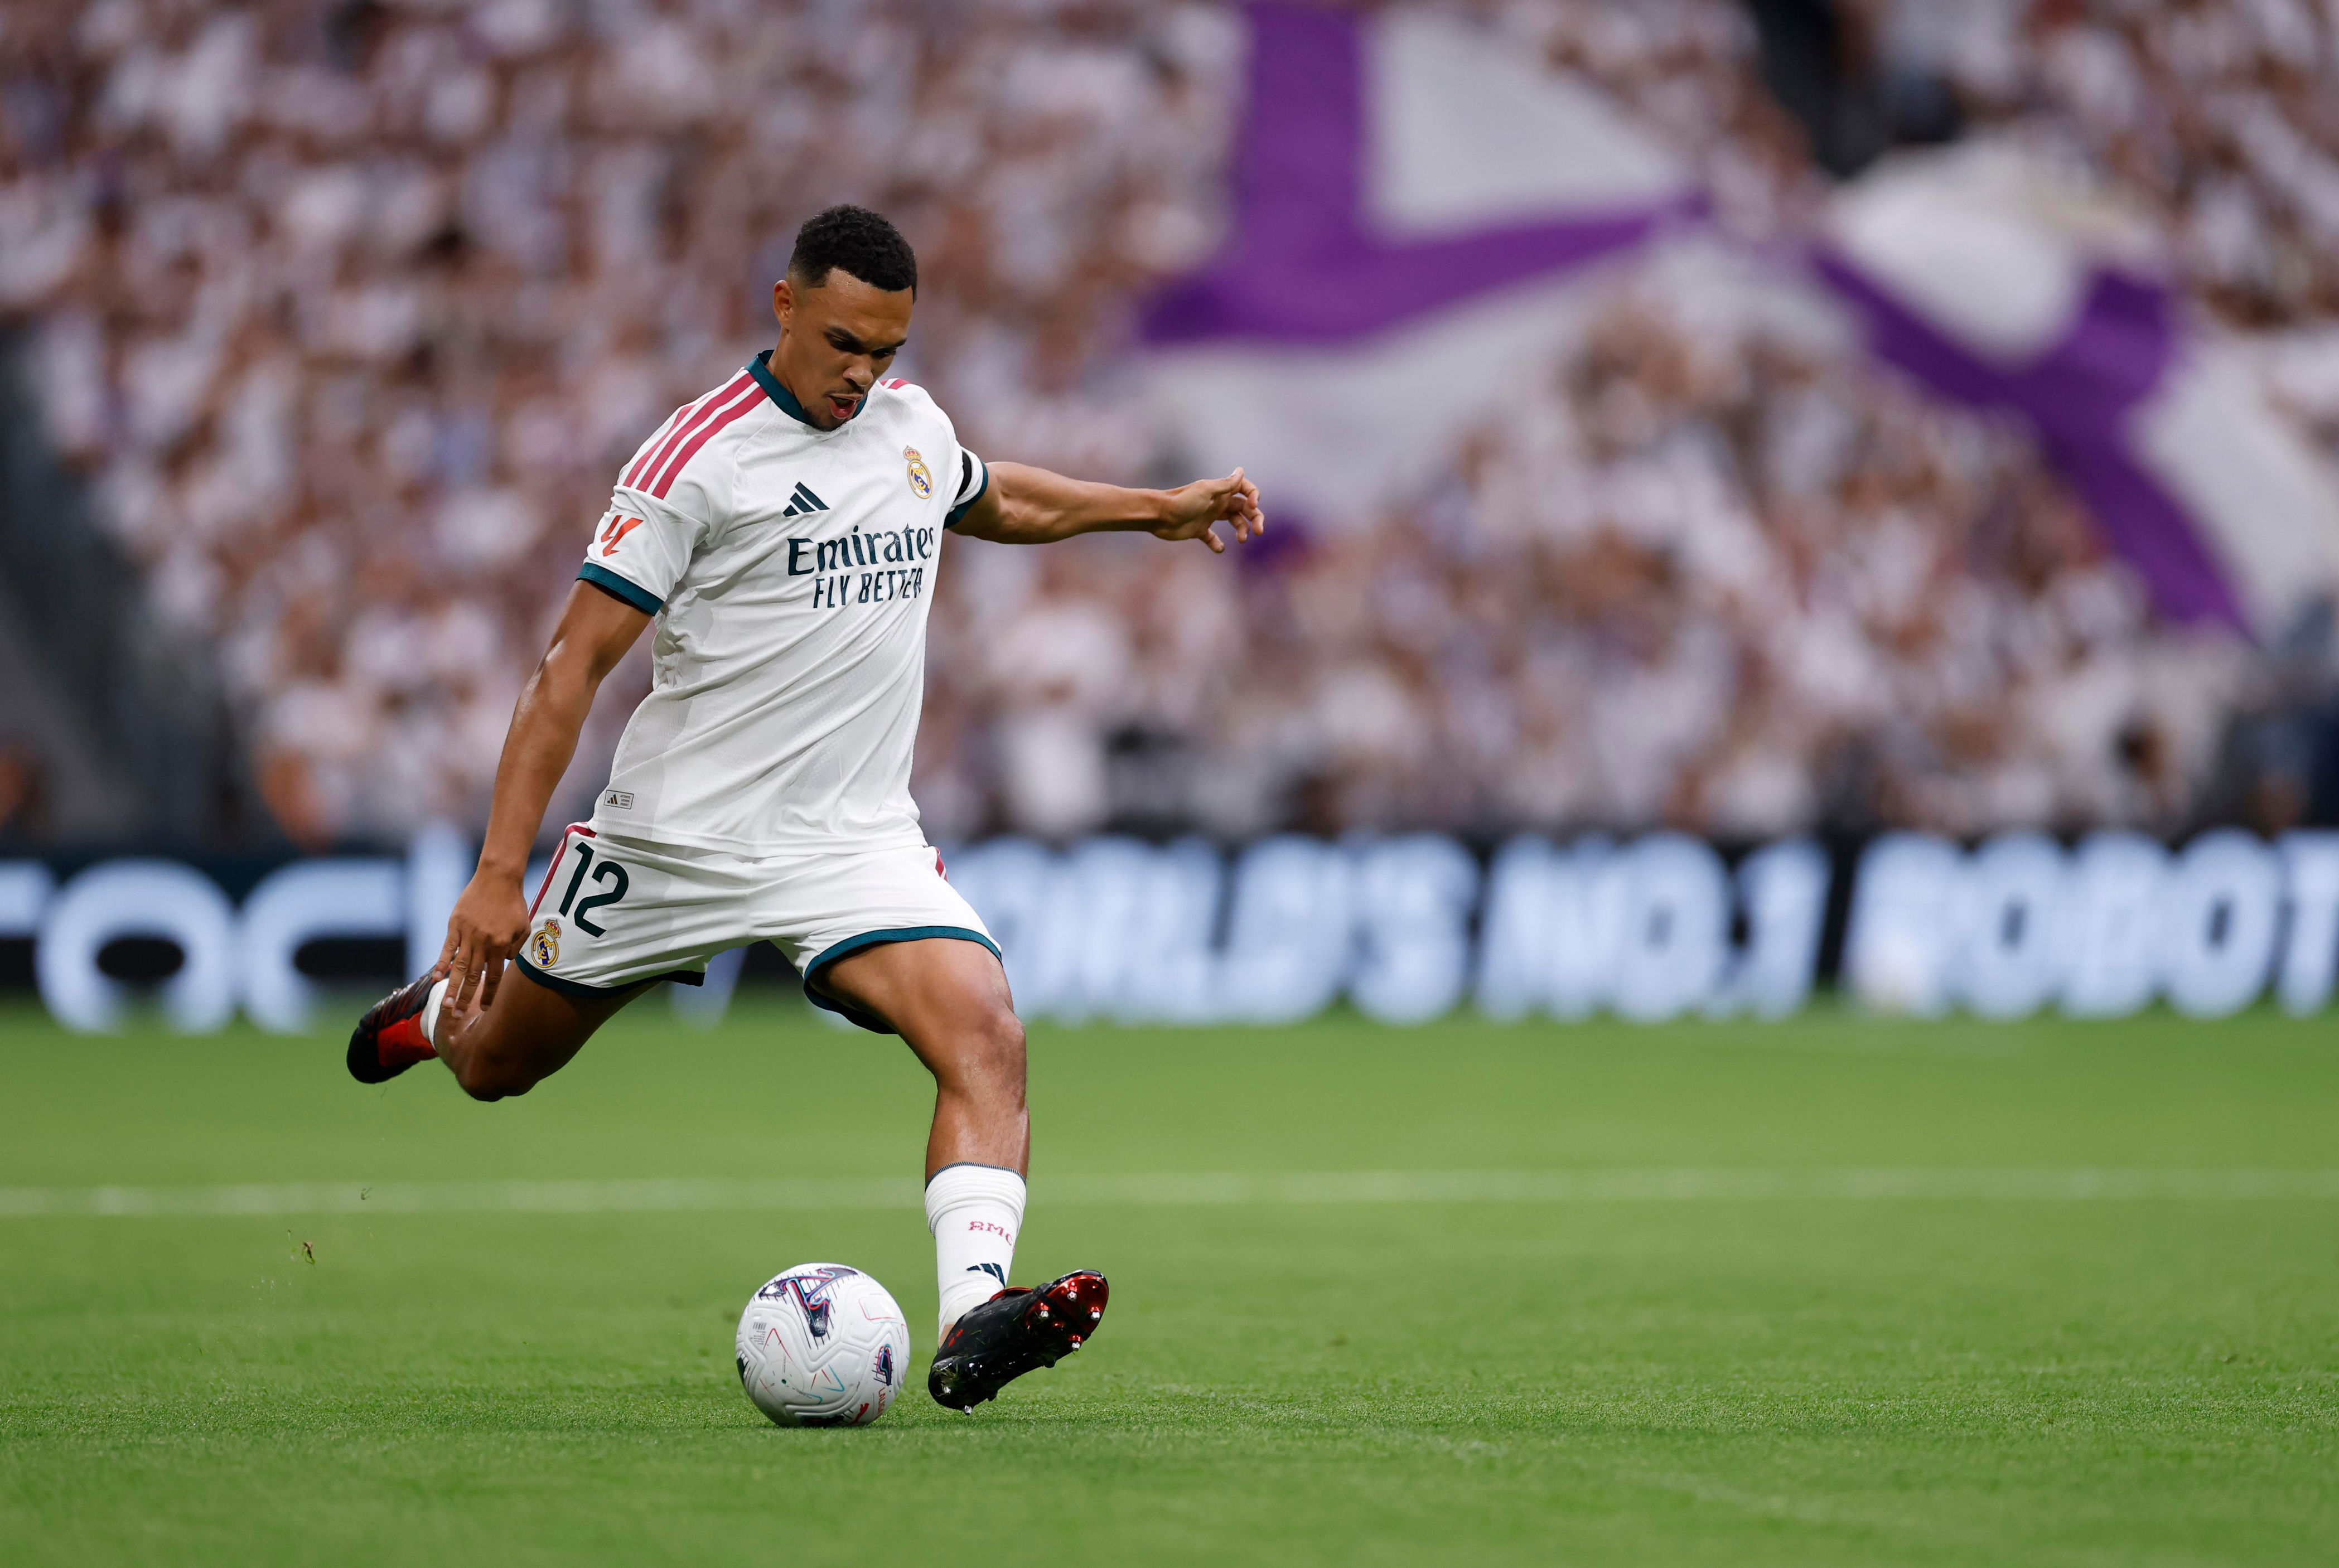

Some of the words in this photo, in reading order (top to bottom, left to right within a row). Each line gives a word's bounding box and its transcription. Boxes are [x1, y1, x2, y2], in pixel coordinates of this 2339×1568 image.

[787, 523, 934, 576] Emirates
[813, 575, 850, 608] FLY
[858, 568, 922, 603] BETTER
[559, 841, 629, 938] 12
[968, 1221, 1015, 1254] RMC
